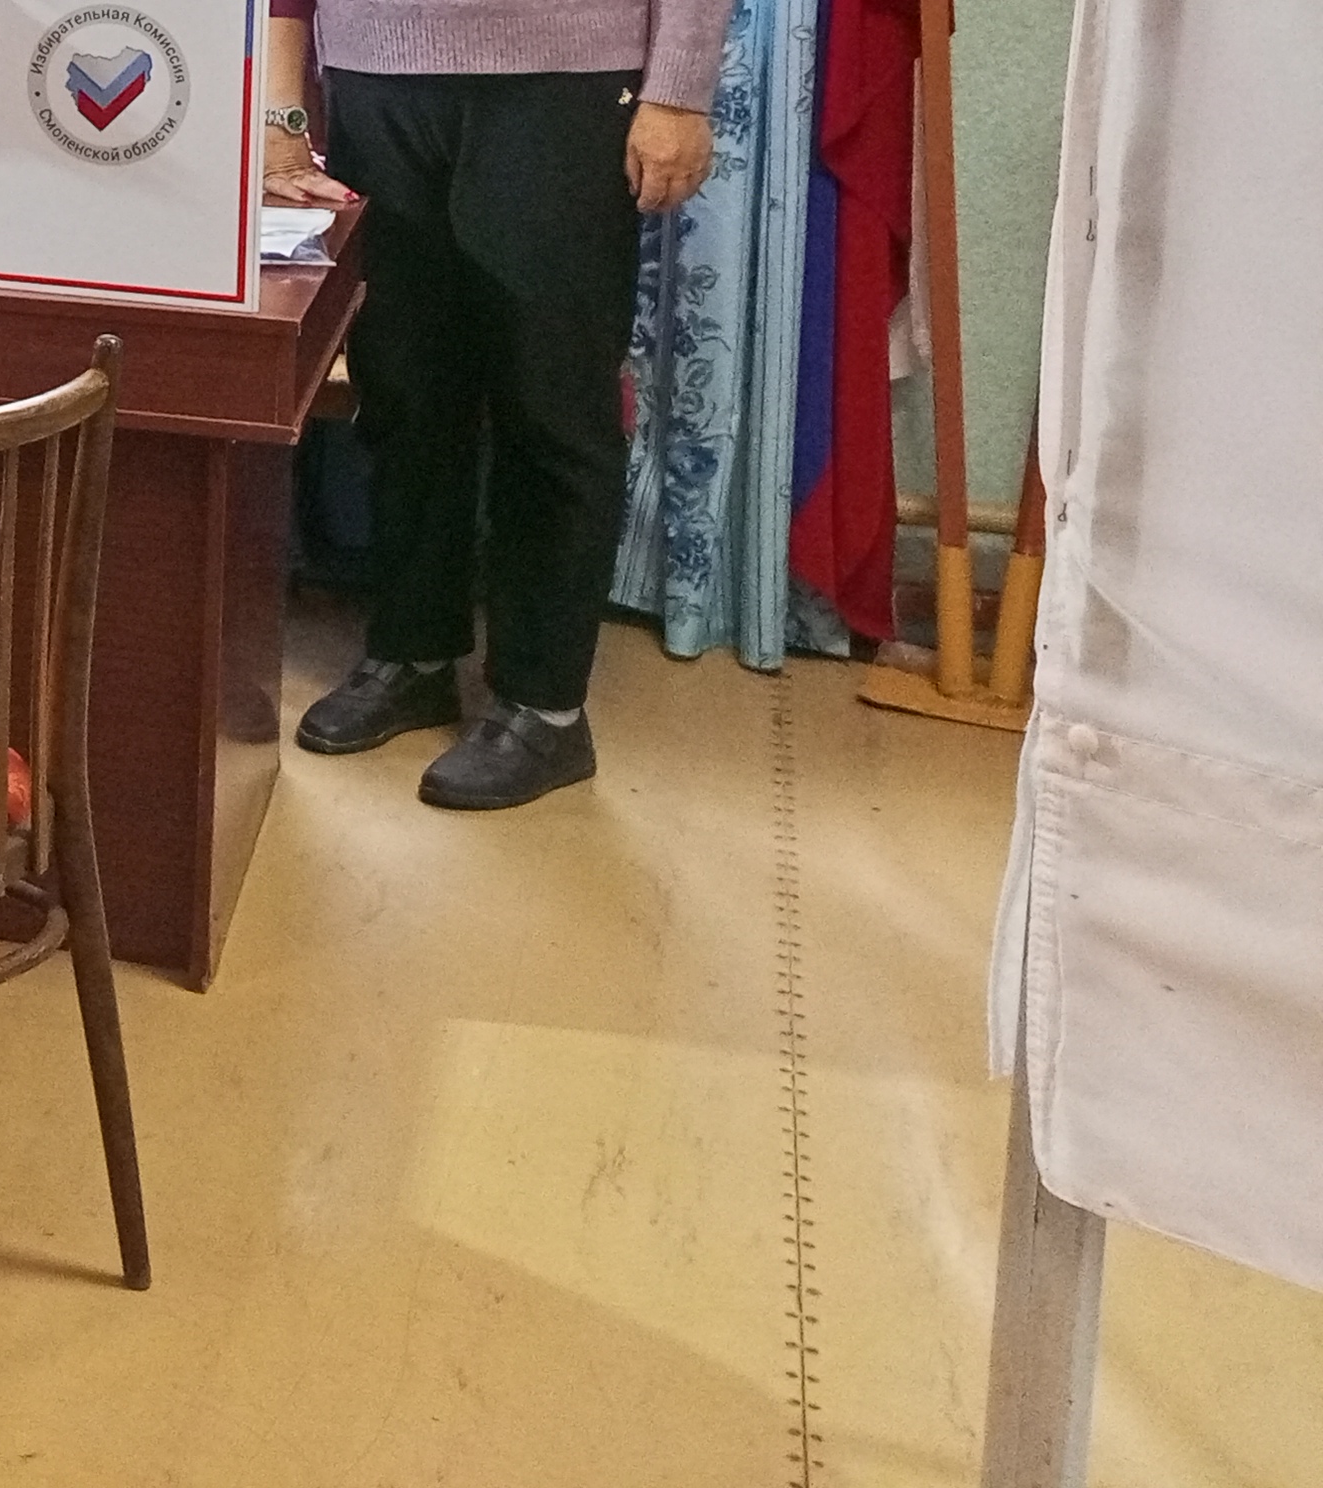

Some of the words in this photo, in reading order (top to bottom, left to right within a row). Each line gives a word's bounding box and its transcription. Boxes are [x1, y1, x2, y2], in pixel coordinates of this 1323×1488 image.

[30, 8, 130, 75] Избирательная
[133, 13, 185, 84] Комиссия
[39, 108, 120, 162] Смоленской
[123, 117, 177, 159] области
